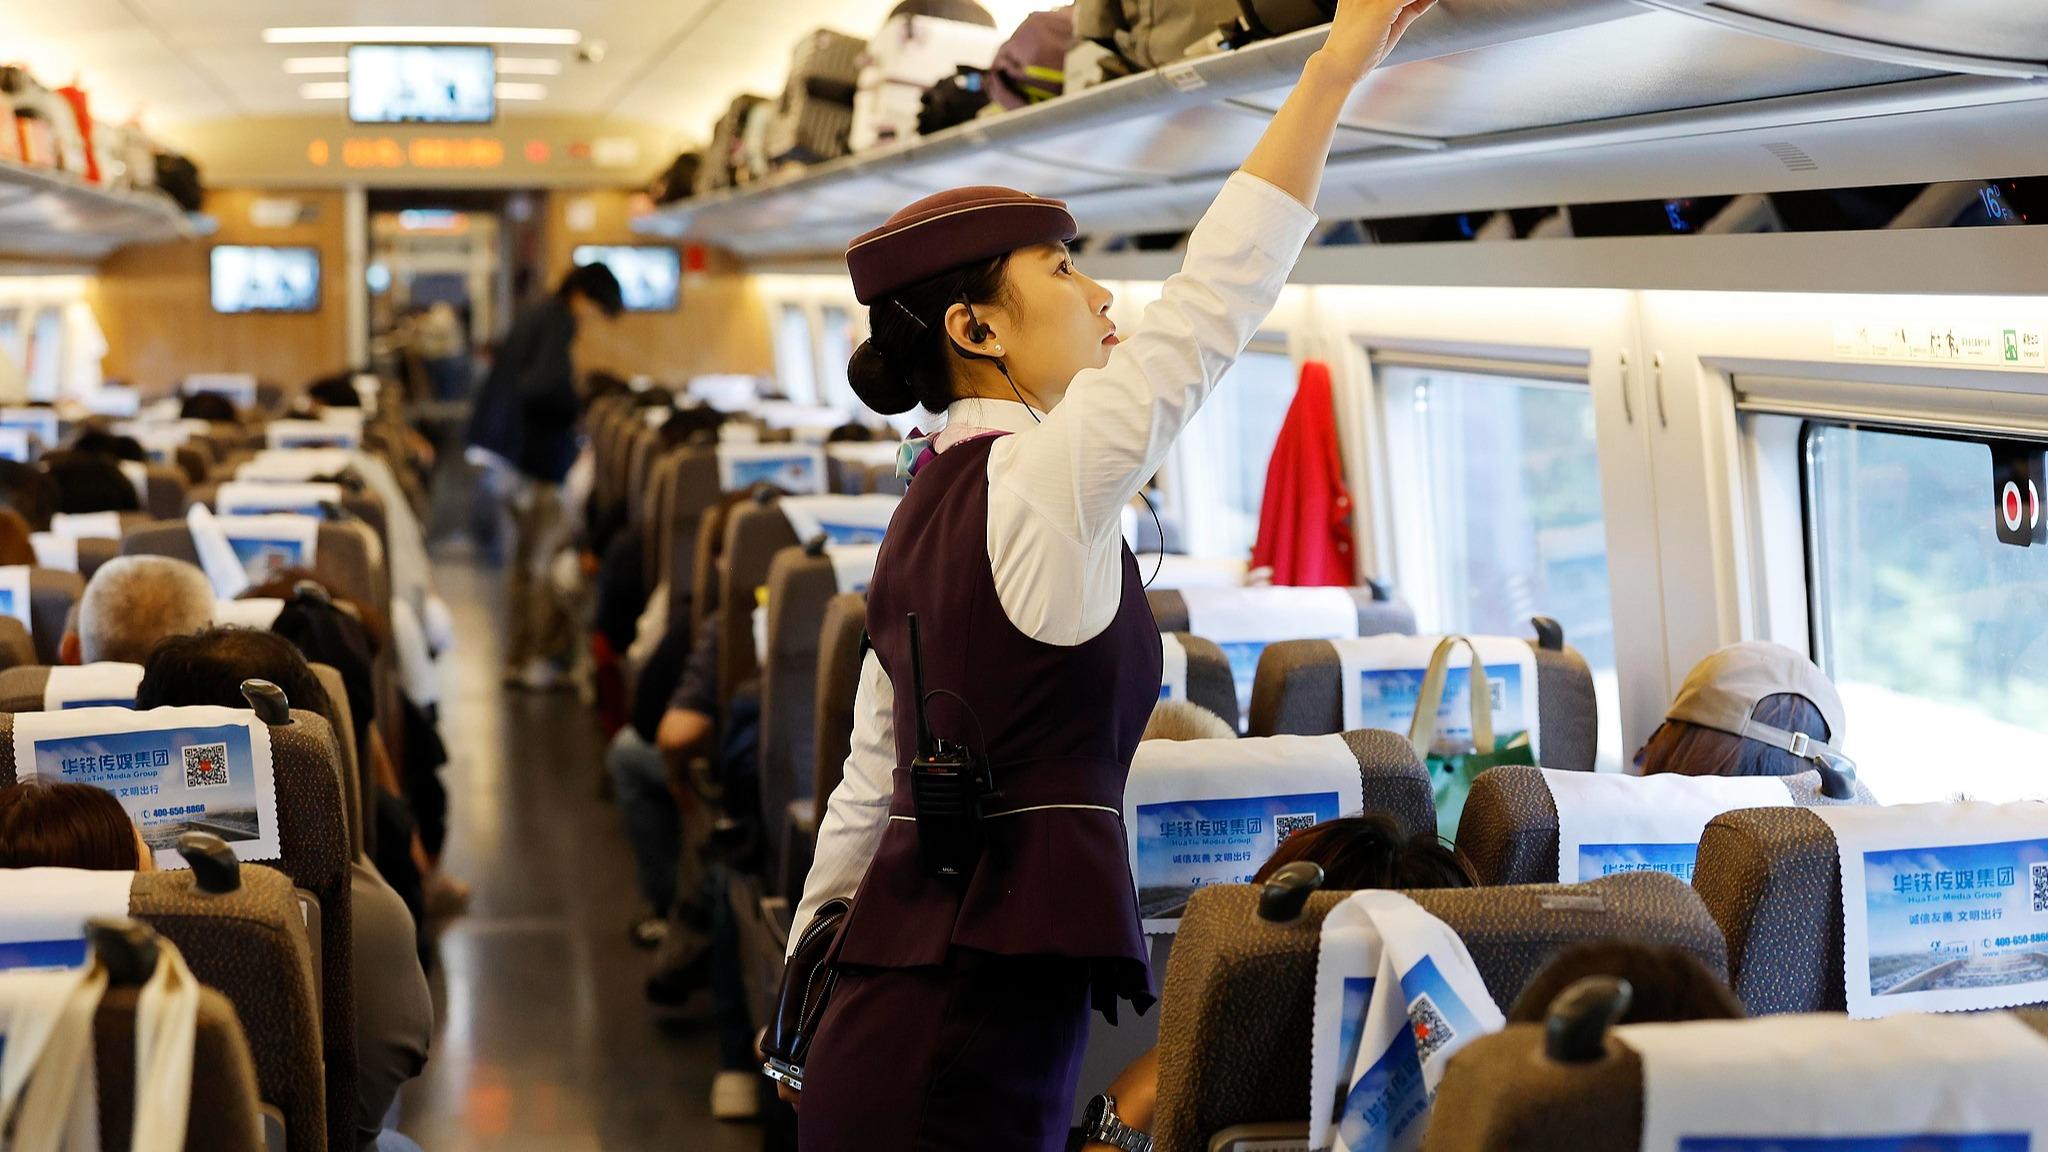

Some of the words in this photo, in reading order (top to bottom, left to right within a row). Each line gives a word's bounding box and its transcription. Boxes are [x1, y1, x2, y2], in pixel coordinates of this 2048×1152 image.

[1979, 187, 2002, 219] 16
[61, 749, 169, 776] 华铁传媒集团
[106, 772, 131, 781] Media
[133, 770, 158, 779] Group
[119, 784, 160, 798] 文明出行
[1159, 817, 1262, 838] 华铁传媒集团
[1171, 838, 1200, 847] HuaTie
[1202, 838, 1226, 846] Media
[1227, 837, 1251, 845] Group
[1172, 853, 1211, 865] 诚信友善
[1214, 851, 1252, 863] 文明出行
[1892, 866, 2015, 894] 华铁传媒集团
[1908, 894, 1940, 904] HuaTie
[1942, 891, 1972, 901] Media
[1974, 891, 2003, 900] Group
[1908, 911, 1953, 926] 诚信友善
[1957, 908, 2003, 922] 文明出行
